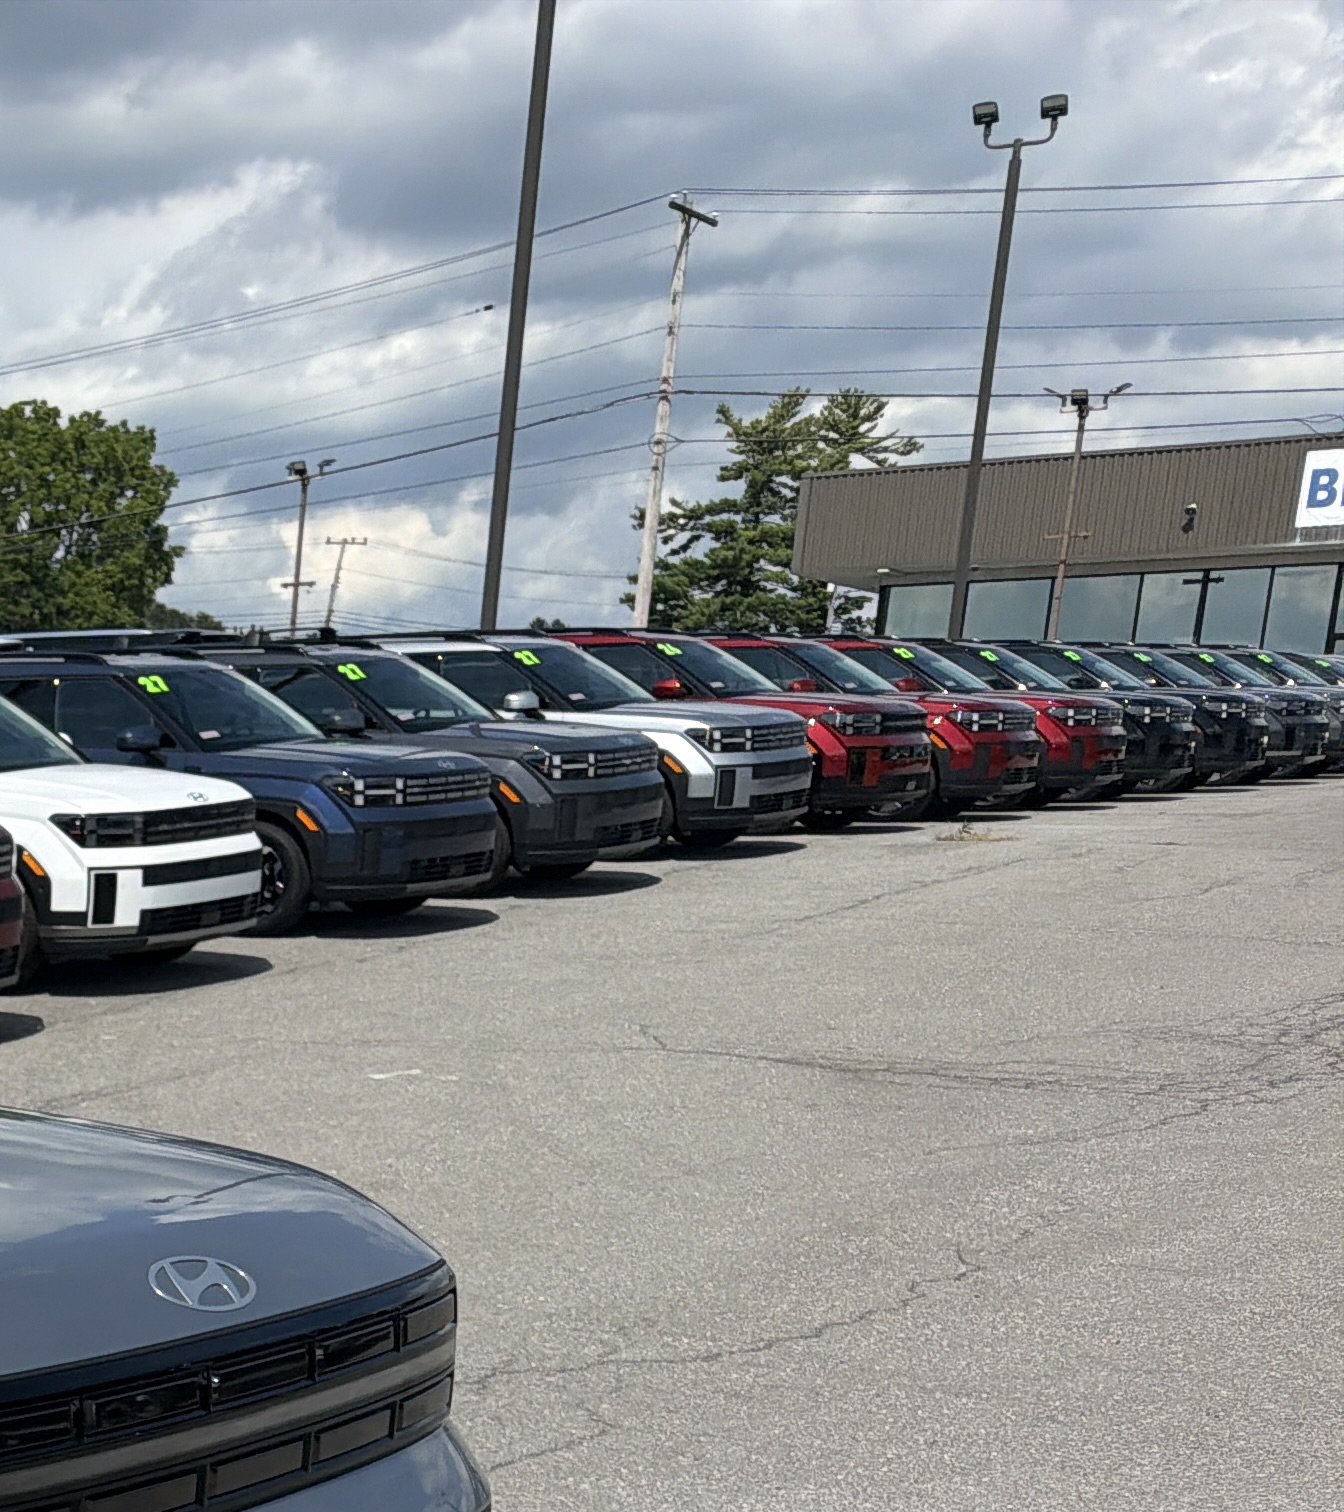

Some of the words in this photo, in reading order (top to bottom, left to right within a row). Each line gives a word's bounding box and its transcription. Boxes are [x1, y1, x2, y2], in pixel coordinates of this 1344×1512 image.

[1306, 467, 1344, 508] B
[337, 663, 367, 680] 27
[137, 675, 170, 693] 27
